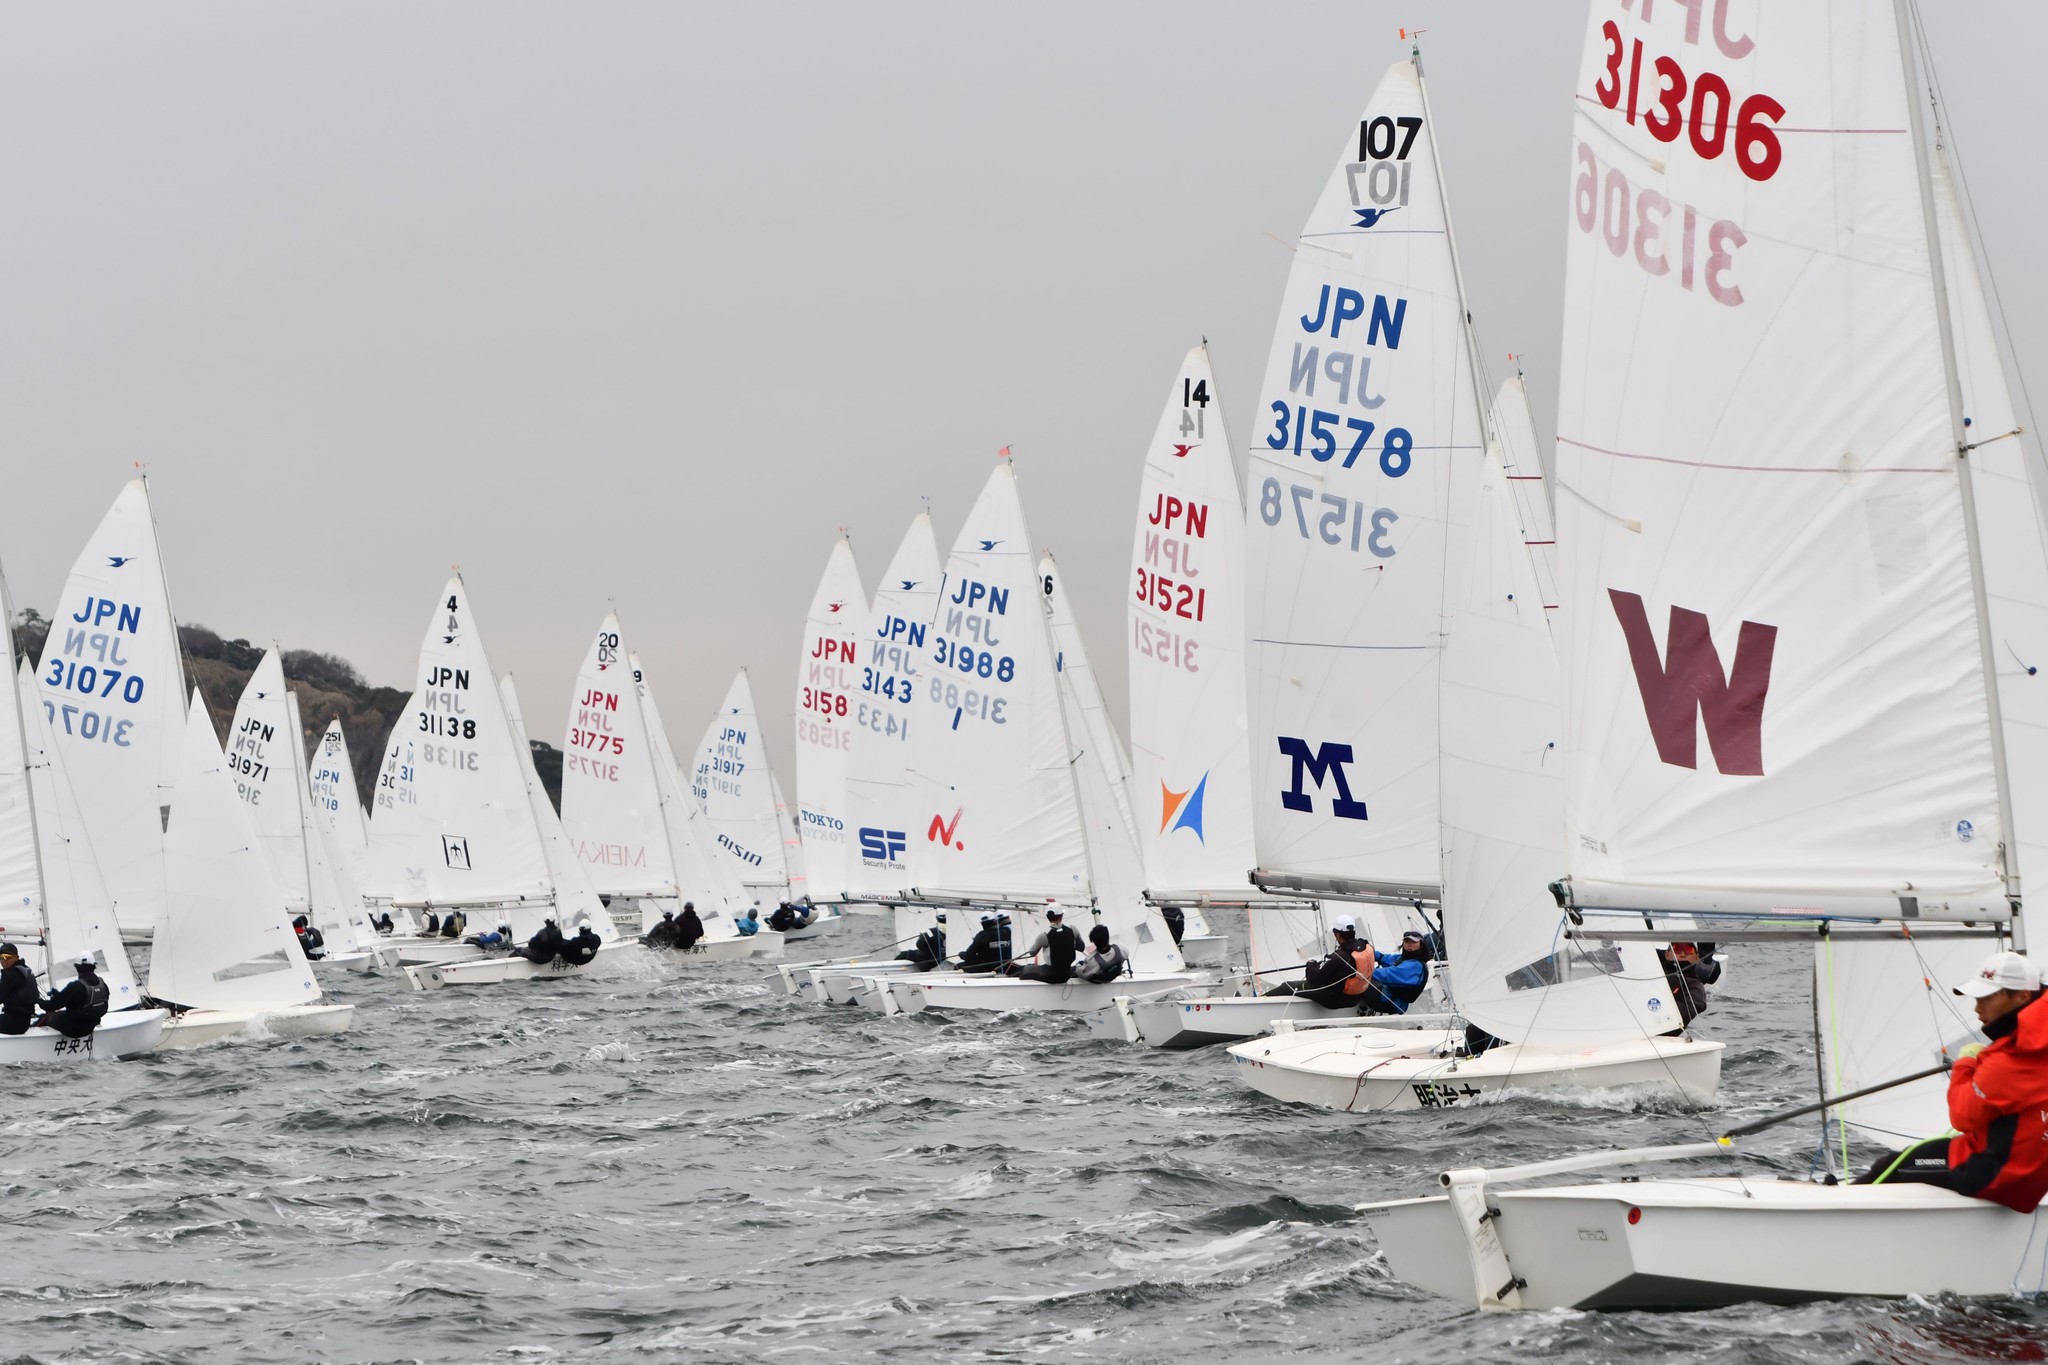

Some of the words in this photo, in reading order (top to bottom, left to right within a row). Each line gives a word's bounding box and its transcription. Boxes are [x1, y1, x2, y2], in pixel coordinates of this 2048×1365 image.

[1595, 20, 1786, 181] 31306
[1359, 116, 1423, 162] 107
[1300, 284, 1407, 350] JPN
[1184, 378, 1210, 408] 14
[1266, 400, 1413, 478] 31578
[1149, 493, 1208, 538] JPN
[447, 596, 458, 612] 4
[951, 579, 1009, 615] JPN
[1136, 567, 1205, 622] 31521
[73, 597, 141, 634] JPN
[599, 632, 618, 648] 20
[877, 615, 927, 648] JPN
[811, 637, 856, 664] JPN
[933, 637, 1015, 683] 31988
[45, 659, 144, 704] 31070
[427, 666, 470, 690] JPN
[862, 667, 912, 704] 3143
[1607, 587, 1778, 776] W
[581, 689, 618, 712] JPN
[802, 686, 848, 717] 3158
[240, 717, 274, 743] JPN
[325, 732, 341, 742] 251
[419, 712, 476, 739] 31138
[720, 728, 746, 745] JPN
[570, 728, 625, 755] 31775
[228, 753, 269, 782] 31971
[315, 769, 339, 783] JPN
[713, 757, 744, 776] 31917
[1278, 736, 1368, 820] M
[801, 809, 844, 831] TOKYO
[859, 827, 906, 861] SF
[863, 859, 886, 870] Security
